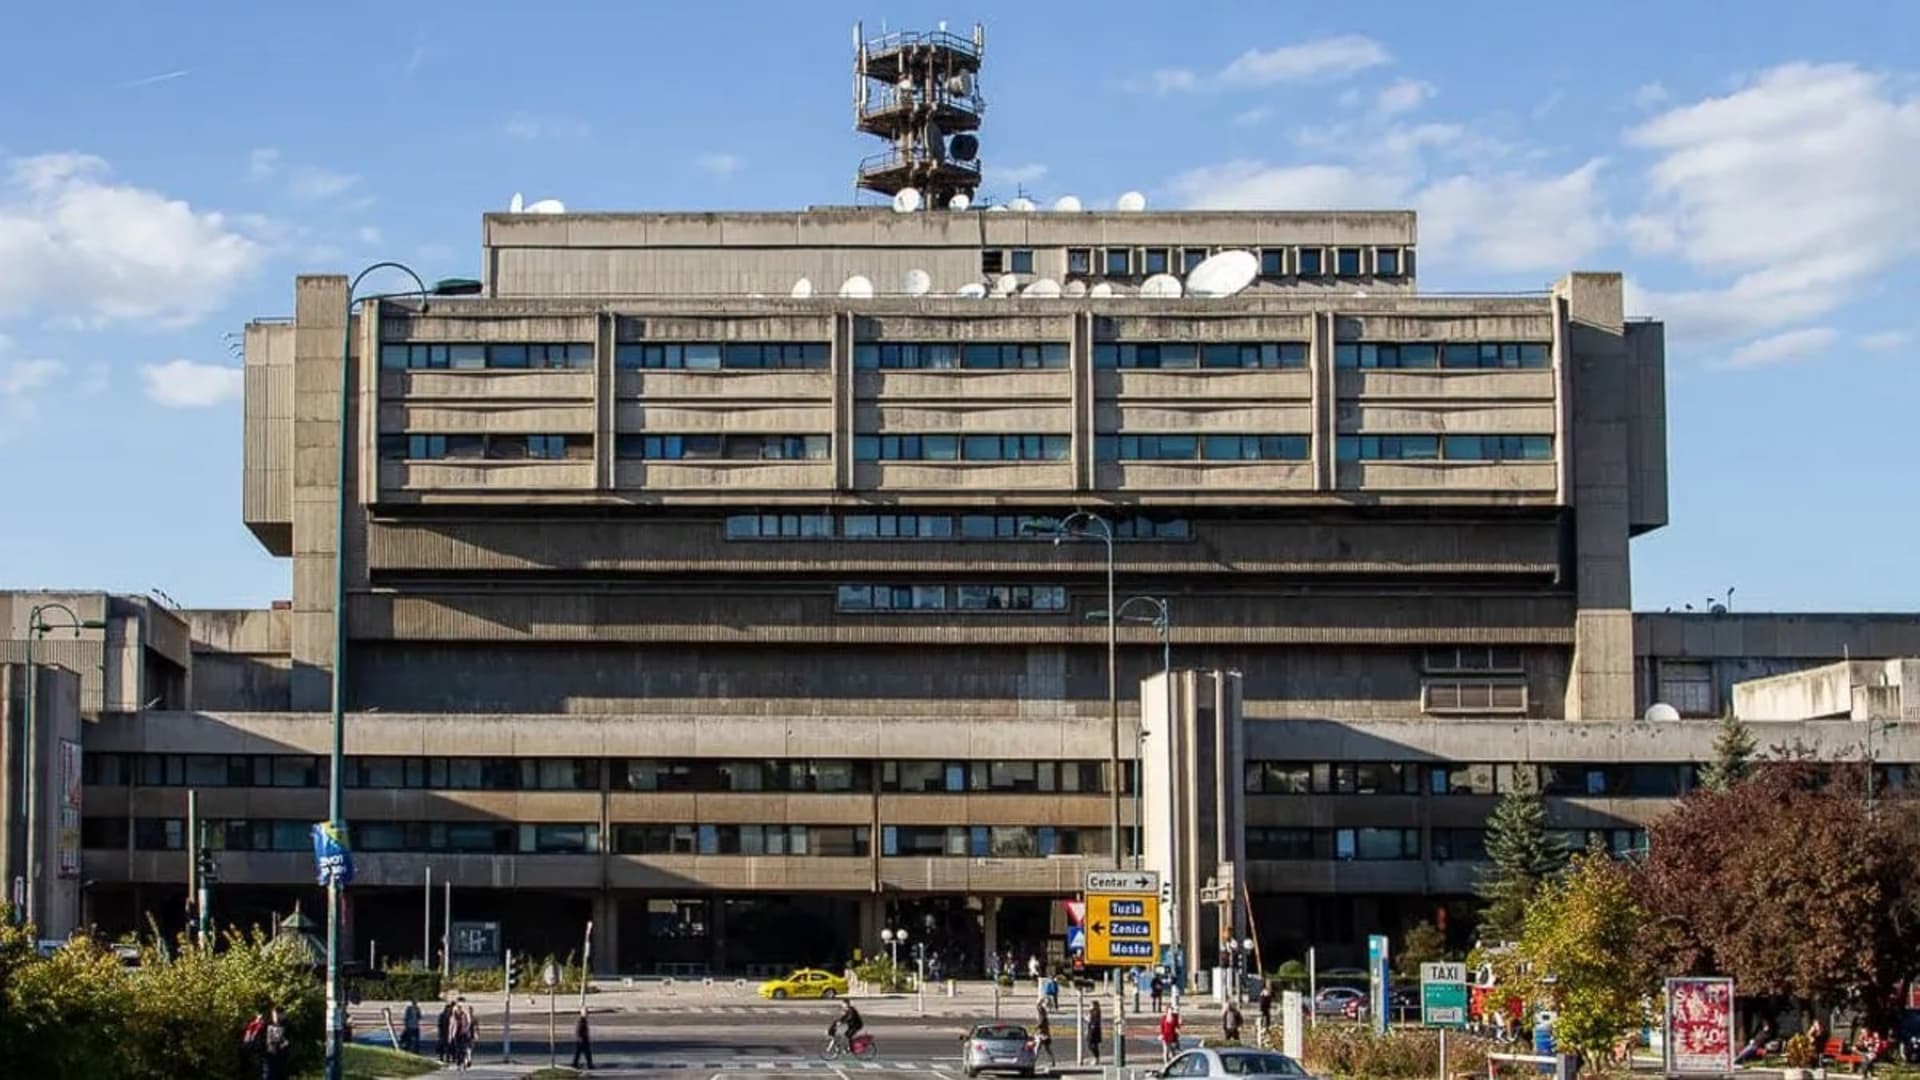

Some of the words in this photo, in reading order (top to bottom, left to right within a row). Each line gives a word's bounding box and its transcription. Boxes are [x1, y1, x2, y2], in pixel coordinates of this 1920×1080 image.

[1089, 876, 1128, 888] Centar
[1111, 902, 1142, 914] Tuzla
[1111, 923, 1149, 935] Zenica
[1111, 943, 1151, 955] Mostar
[1432, 966, 1458, 980] TAXI
